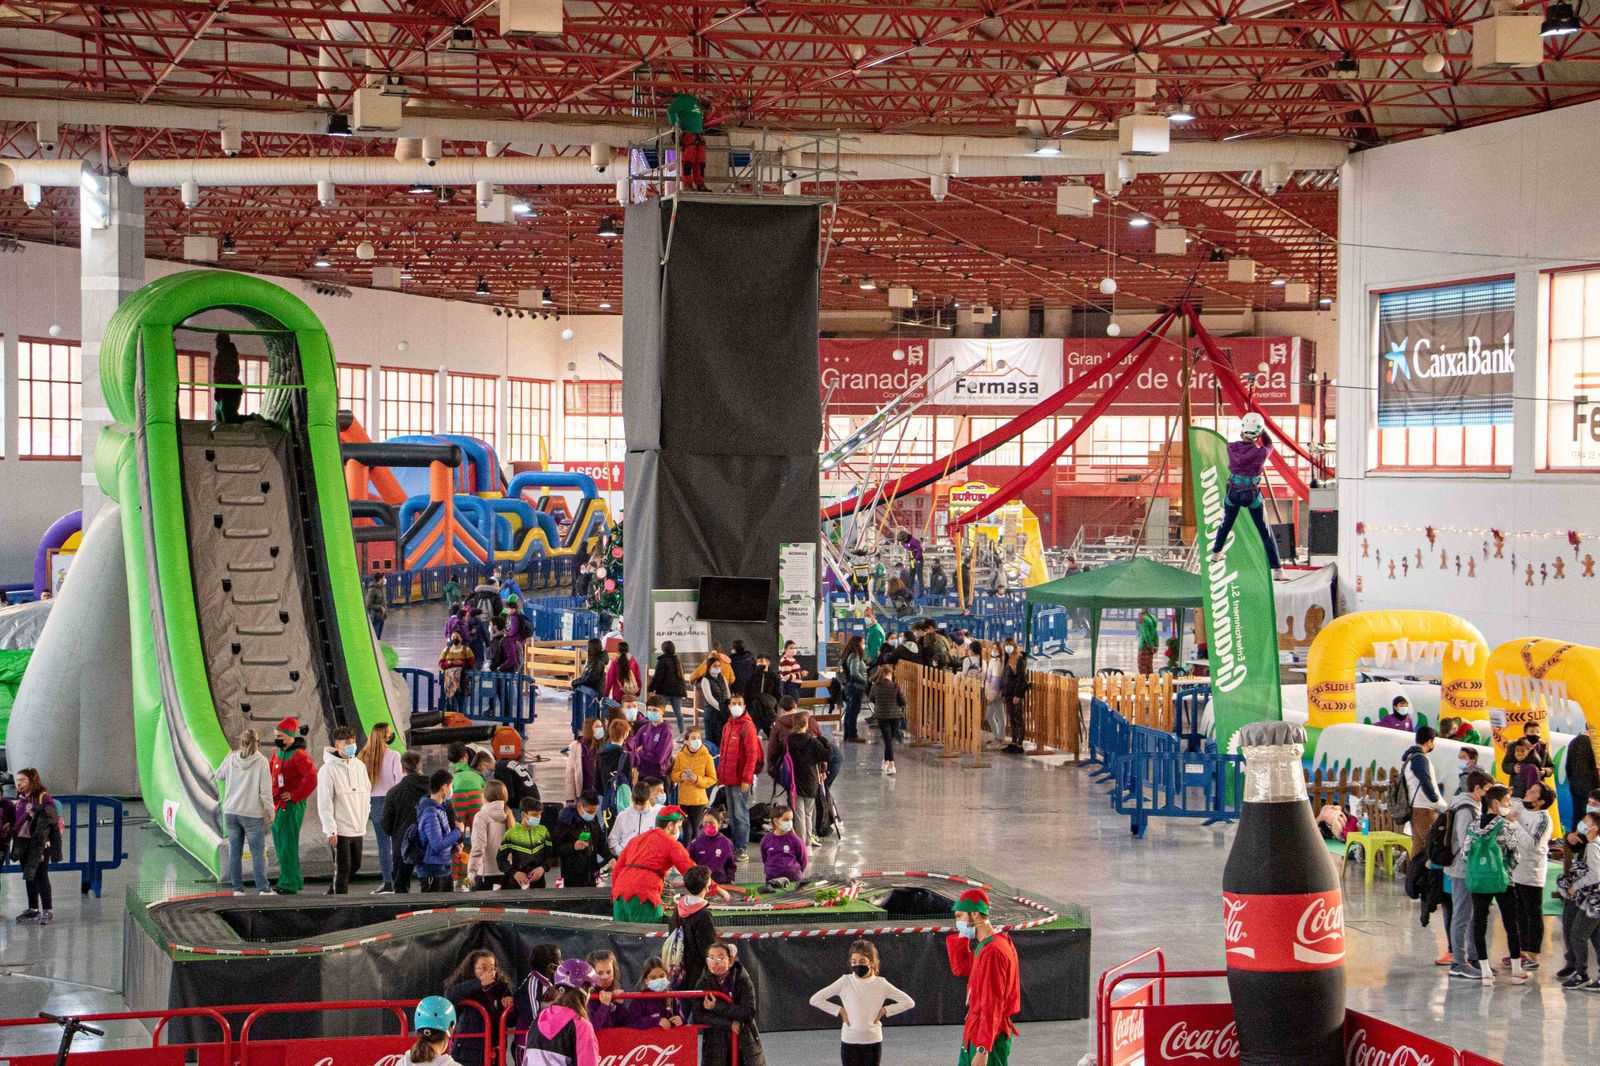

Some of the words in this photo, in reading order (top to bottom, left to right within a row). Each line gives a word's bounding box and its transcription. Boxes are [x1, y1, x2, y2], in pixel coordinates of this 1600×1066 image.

[1067, 352, 1103, 365] Gran
[1412, 333, 1510, 379] CaixaBank
[821, 368, 924, 390] Granada
[1136, 368, 1169, 389] de
